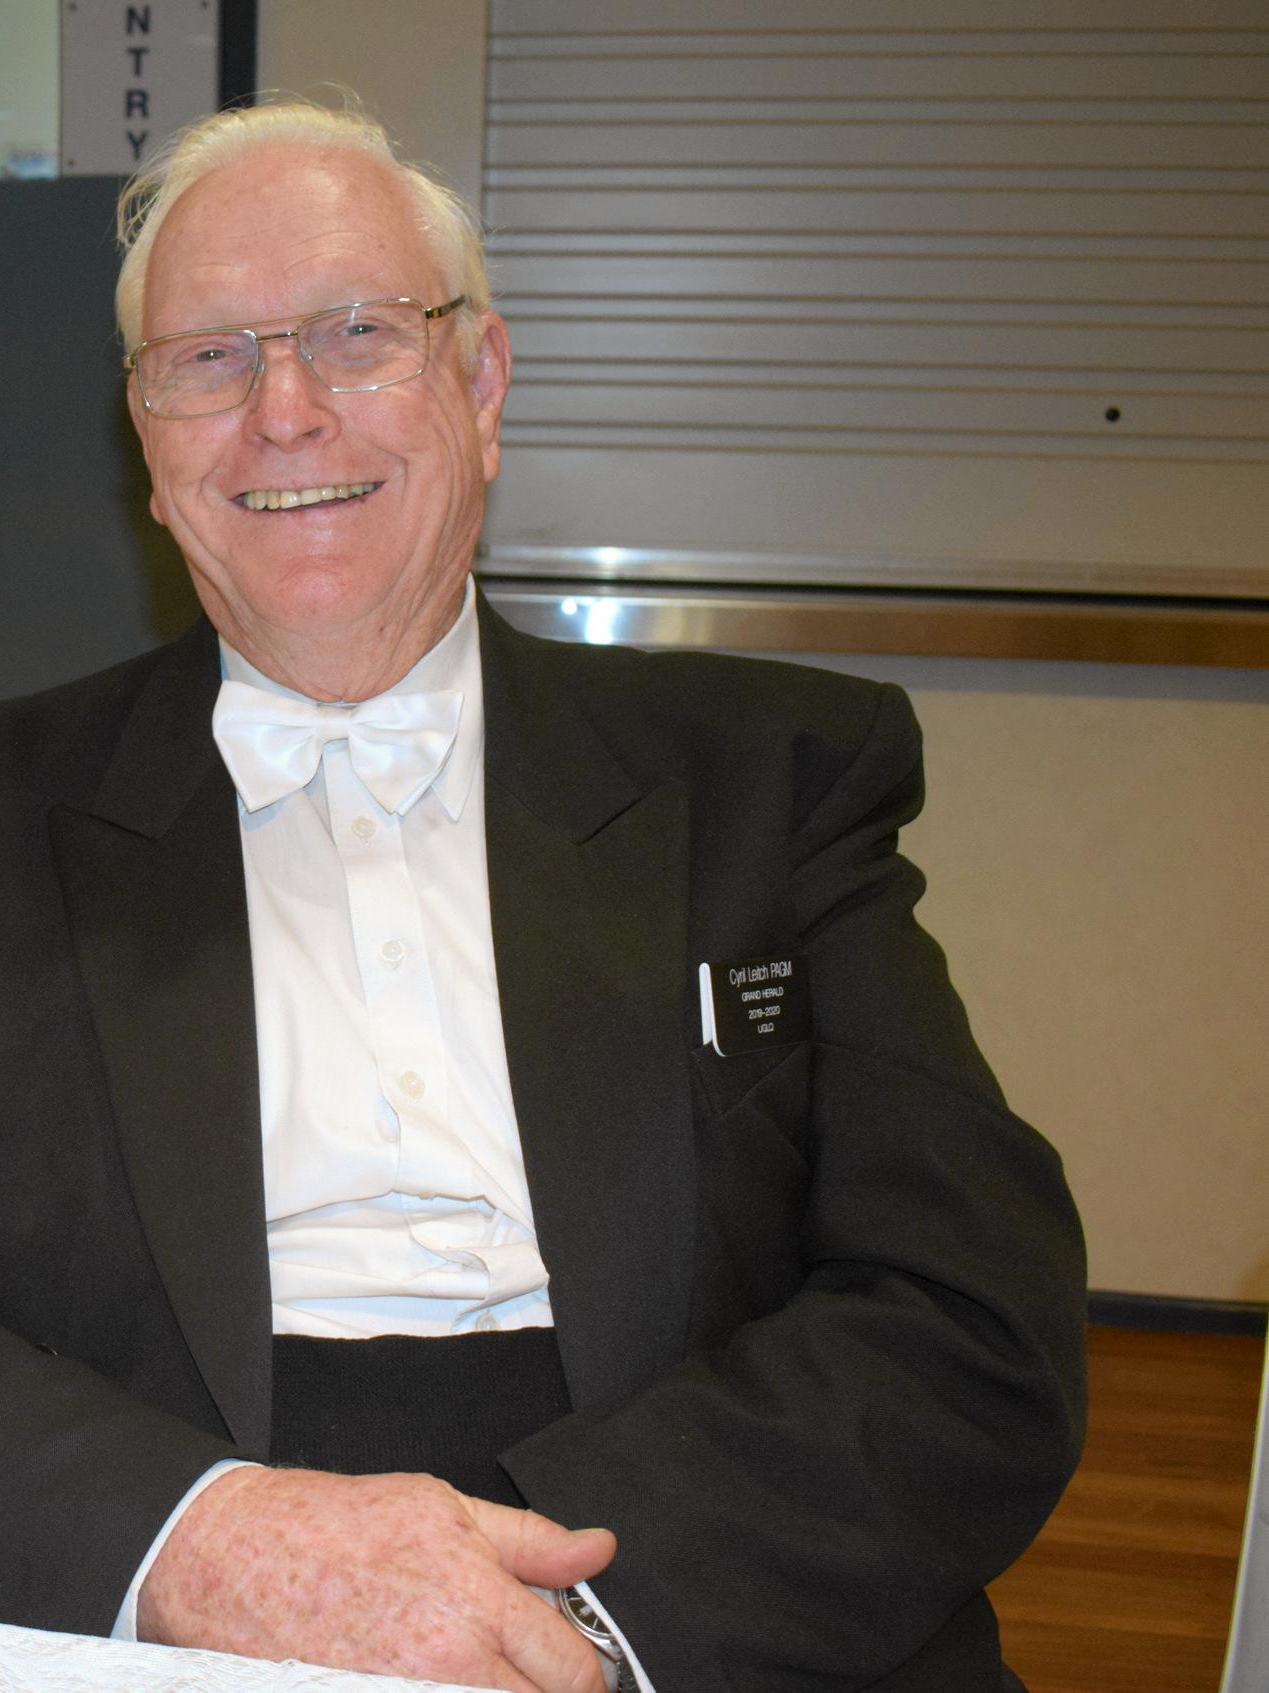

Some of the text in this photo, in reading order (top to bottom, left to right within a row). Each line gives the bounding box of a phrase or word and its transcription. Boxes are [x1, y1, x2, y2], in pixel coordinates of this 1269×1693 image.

[729, 961, 792, 987] Cyril Leitch PAGM
[741, 986, 784, 1002] GRAND HERALD
[748, 1005, 780, 1019] 2019-2020
